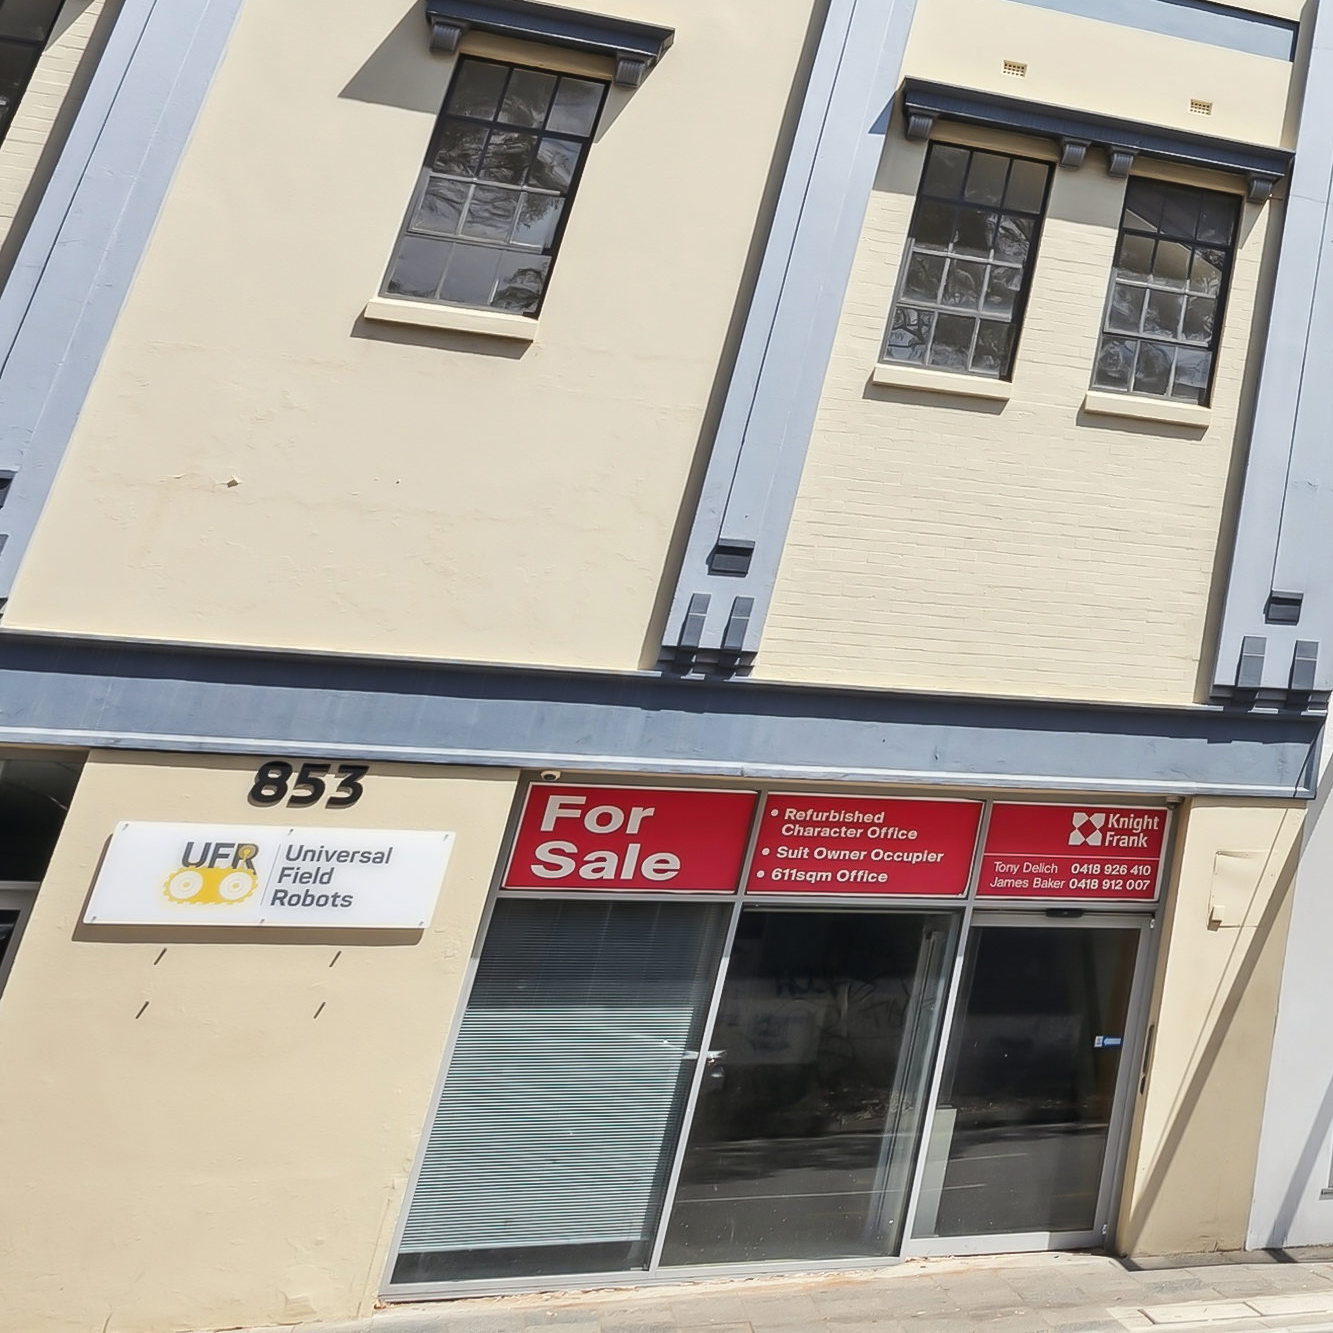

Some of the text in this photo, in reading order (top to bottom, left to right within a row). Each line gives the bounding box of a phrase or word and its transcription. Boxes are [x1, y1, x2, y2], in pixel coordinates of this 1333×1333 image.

[248, 760, 370, 808] 853
[540, 794, 656, 835] For
[784, 808, 885, 823] Refurbished
[1108, 813, 1159, 833] Knight
[781, 823, 918, 840] Character Office
[1105, 831, 1148, 848] Frank
[182, 841, 259, 874] UFR
[285, 844, 394, 864] Universal
[530, 840, 681, 881] Sale
[776, 846, 944, 864] Suit Owner Occupier
[277, 866, 335, 885] Field
[771, 868, 889, 883] 611sqm Office
[994, 862, 1151, 875] Tony Delich 0418 926 410
[990, 877, 1150, 890] James Baker 0418 912 007
[270, 888, 354, 908] Robots
